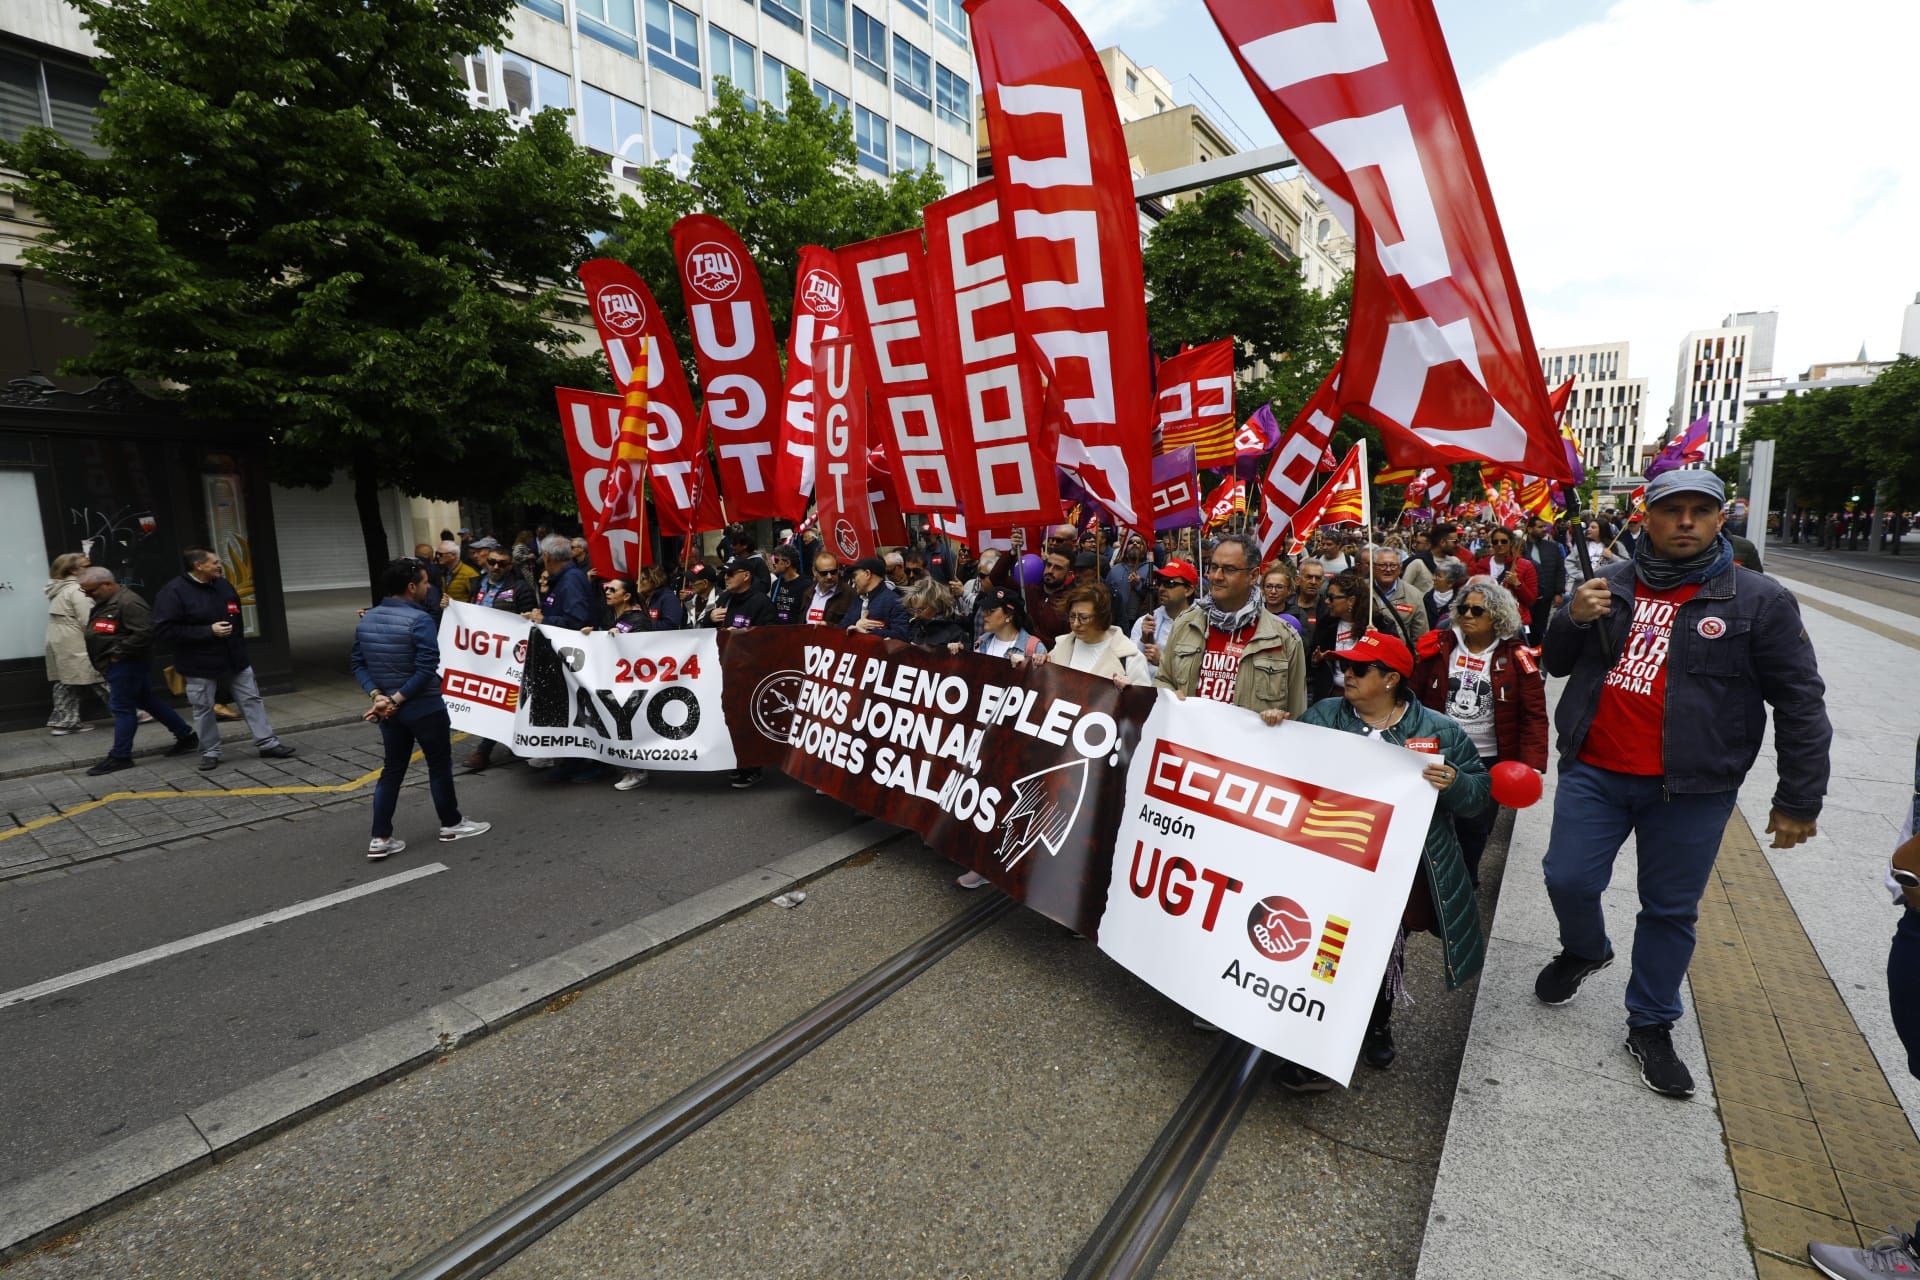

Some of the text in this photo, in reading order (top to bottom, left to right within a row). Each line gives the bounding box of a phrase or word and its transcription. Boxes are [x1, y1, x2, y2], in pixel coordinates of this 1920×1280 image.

[856, 252, 956, 507] CCOO
[946, 200, 1040, 515] CCOO
[826, 343, 852, 513] UGT
[454, 625, 510, 659] UGT
[615, 655, 701, 683] 2024
[446, 674, 507, 704] CCOO
[832, 652, 857, 687] EL
[859, 657, 969, 715] PLENO
[1138, 803, 1196, 840] Aragón
[1153, 752, 1301, 828] CCOO
[1128, 839, 1244, 933] UGT
[1221, 958, 1326, 1022] Aragón
